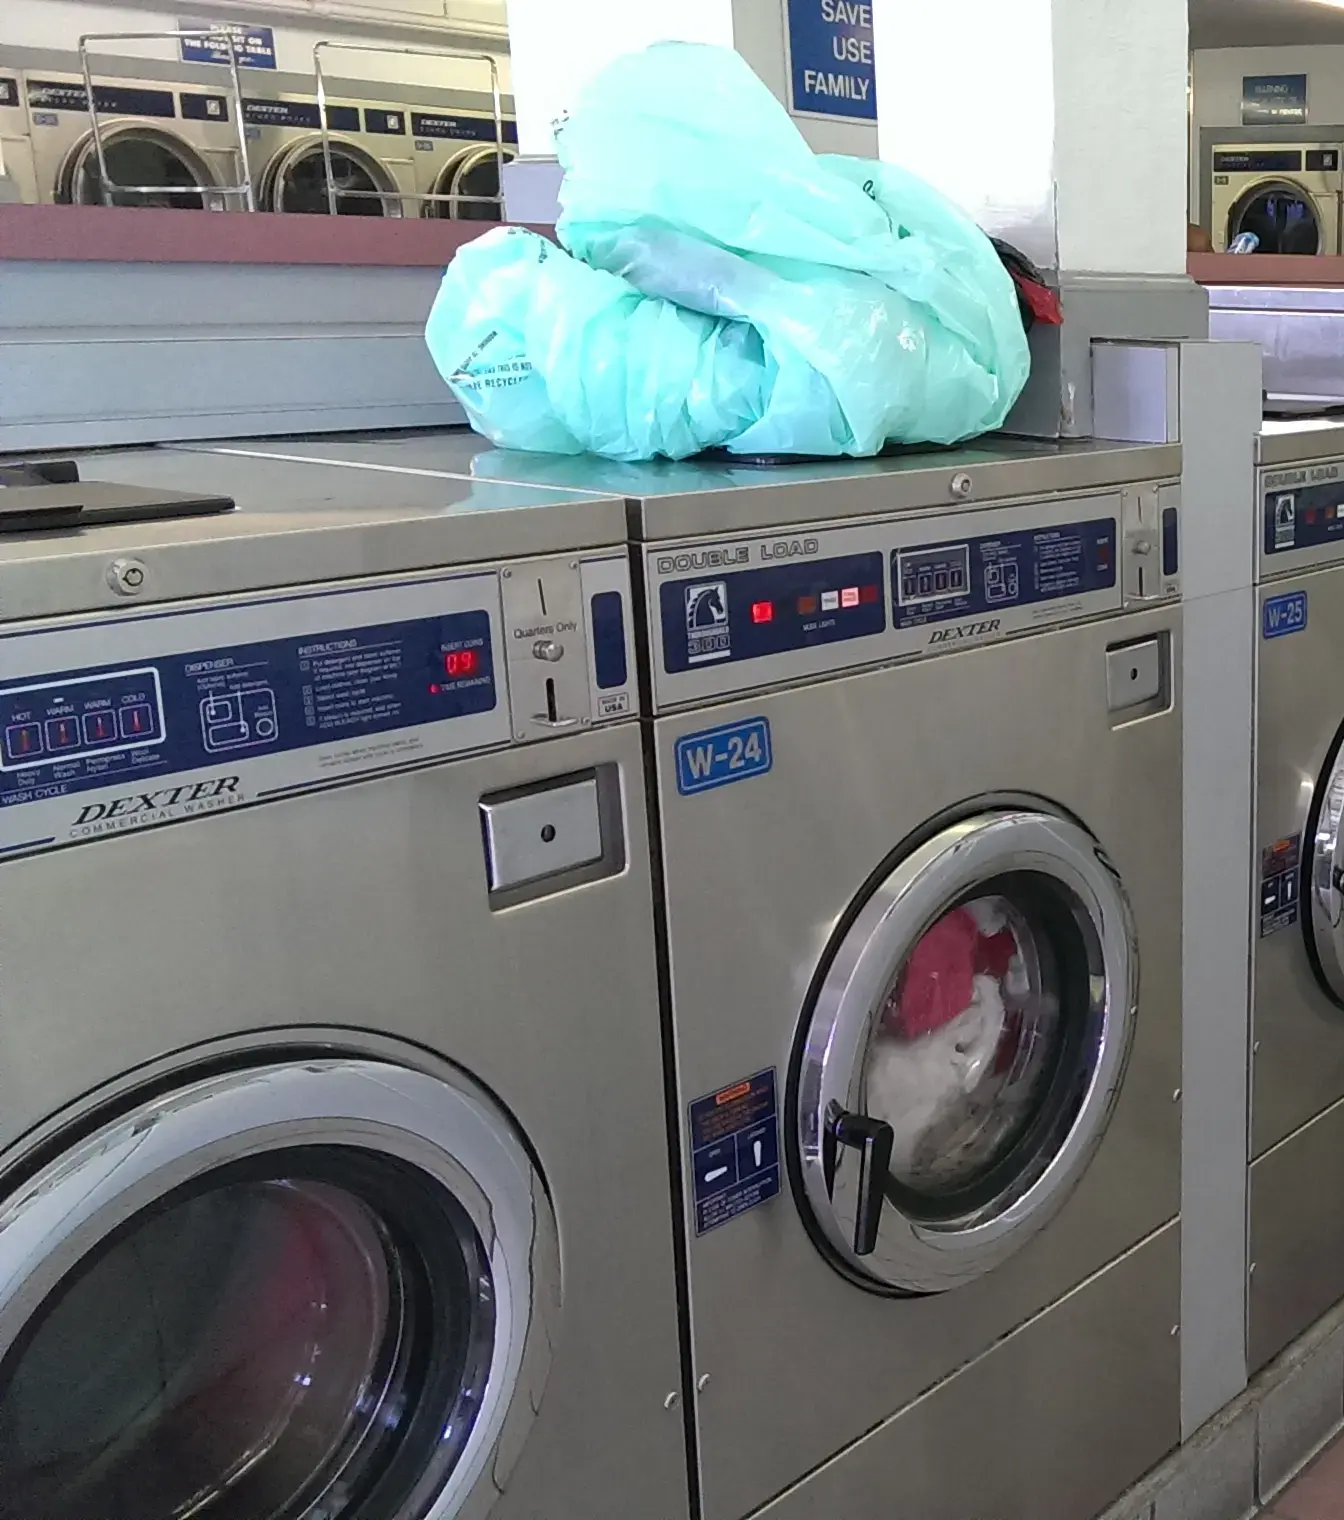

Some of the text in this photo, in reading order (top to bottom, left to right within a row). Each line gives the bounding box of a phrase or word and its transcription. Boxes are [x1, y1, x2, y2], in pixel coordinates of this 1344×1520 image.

[821, 0, 871, 28] SAVE
[833, 36, 872, 65] USE
[804, 69, 869, 101] FAMILY
[657, 538, 819, 574] DOUBLE LOAD
[1268, 600, 1303, 627] W-25
[513, 621, 577, 640] Quarters Only
[928, 619, 1001, 644] DEXTER
[445, 652, 473, 674] 09
[45, 704, 75, 716] WARM
[83, 697, 112, 710] WARM
[120, 692, 146, 704] COLD
[603, 702, 624, 713] USA
[11, 711, 32, 722] HOT
[686, 730, 762, 780] W-24
[2, 784, 68, 804] WASH CYCLE
[71, 775, 240, 826] DEXTER
[69, 793, 246, 839] COMMERCIAL WASHER
